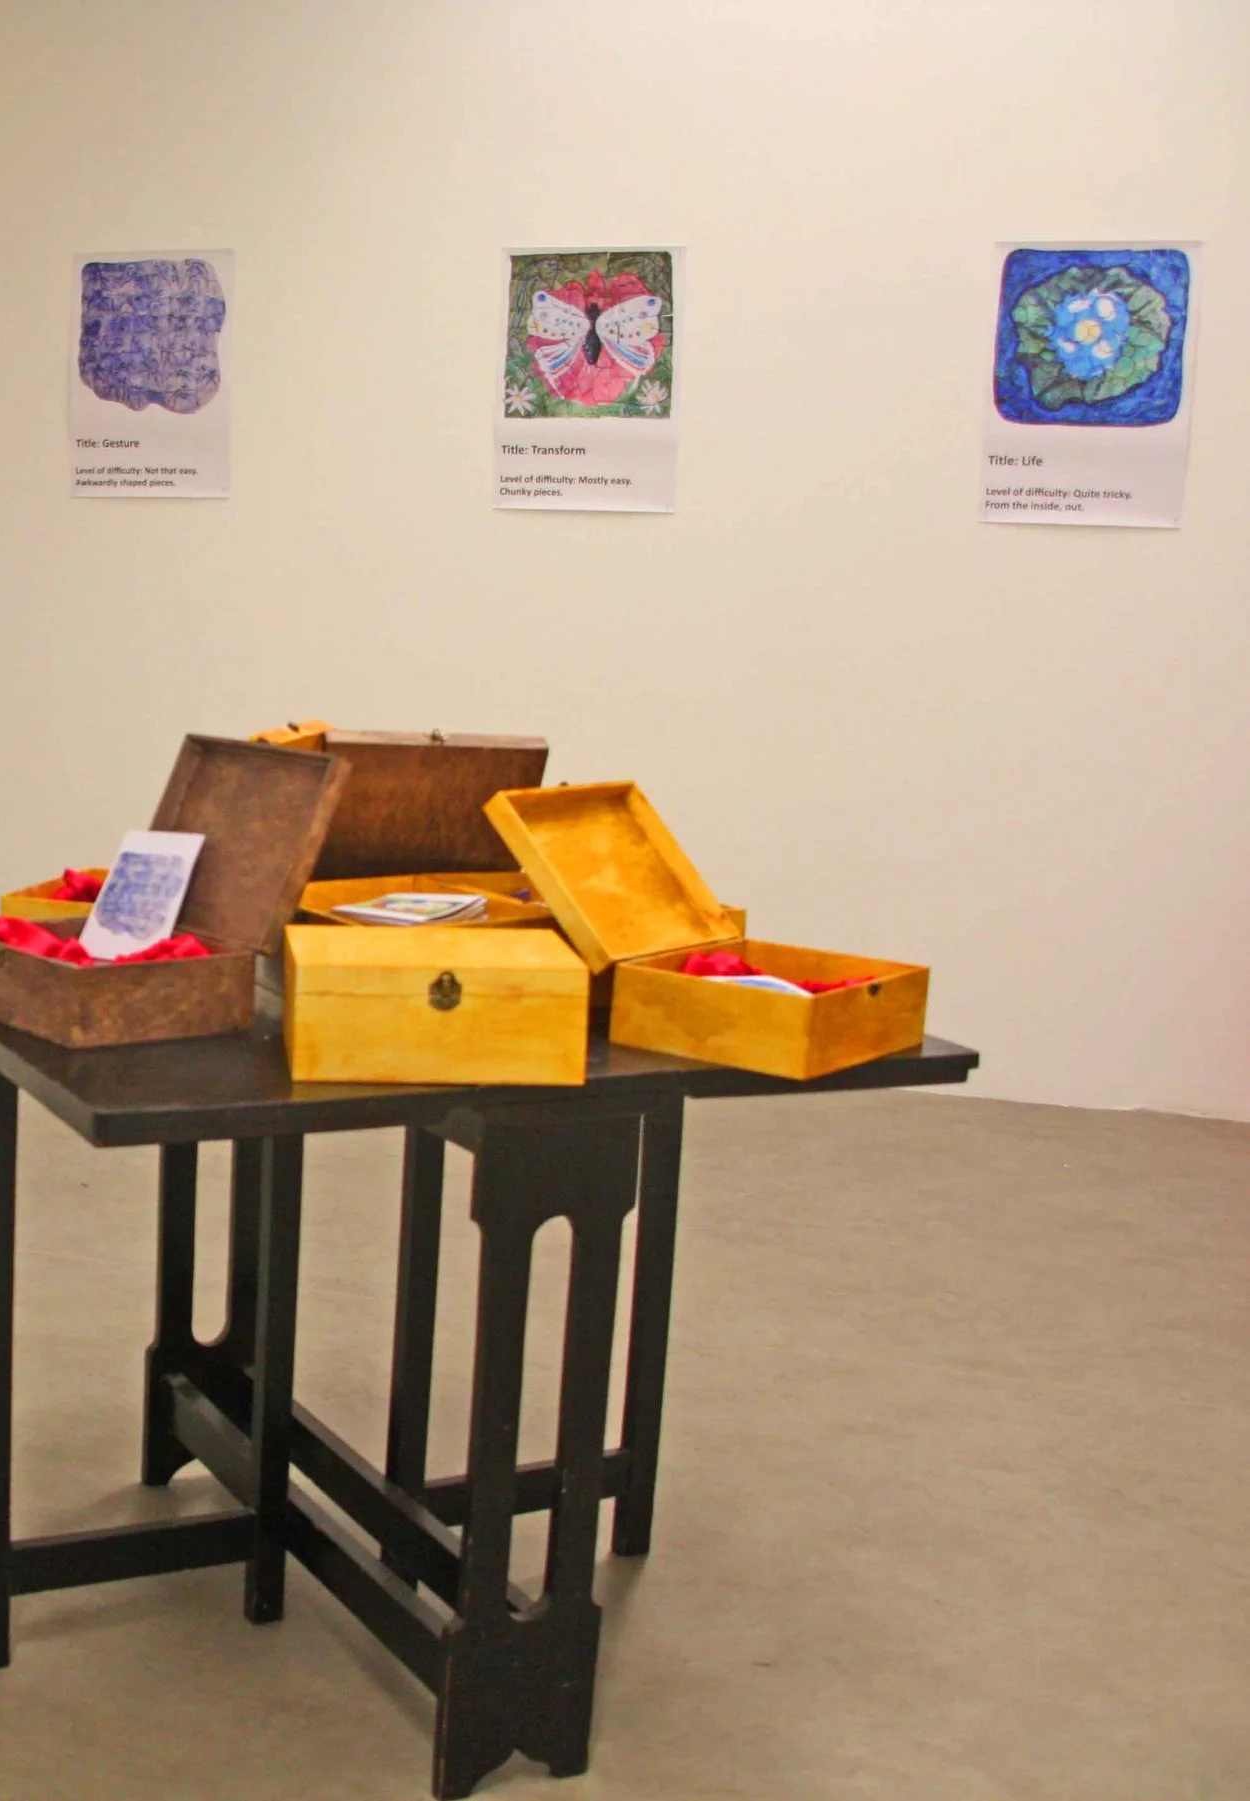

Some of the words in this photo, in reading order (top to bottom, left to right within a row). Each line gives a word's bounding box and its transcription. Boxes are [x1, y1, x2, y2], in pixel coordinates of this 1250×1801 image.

[75, 439, 100, 448] Title:
[102, 439, 140, 448] Gesture
[502, 445, 528, 455] Title:
[531, 445, 586, 455] Transform
[988, 455, 1018, 466] Title:
[1022, 456, 1043, 467] Life
[75, 467, 95, 475] Level
[97, 467, 105, 475] of
[107, 467, 142, 476] difficulty:
[145, 467, 159, 475] Not
[161, 467, 176, 475] that
[75, 479, 118, 487] Awkwardly
[500, 475, 522, 483] Level
[524, 475, 534, 483] of
[535, 475, 576, 485] difficulty:
[578, 476, 608, 485] Mostly
[610, 478, 632, 486] easy.
[500, 487, 531, 496] Chunky
[533, 489, 563, 497] pieces.
[986, 487, 1011, 496] Level
[1013, 487, 1023, 497] of
[1025, 488, 1070, 499] difficulty:
[1073, 489, 1101, 499] Quite
[1102, 490, 1132, 500] tricky.
[985, 500, 1010, 509] From
[1012, 502, 1028, 510] the
[1030, 502, 1062, 512] inside,
[1065, 503, 1084, 511] out.
